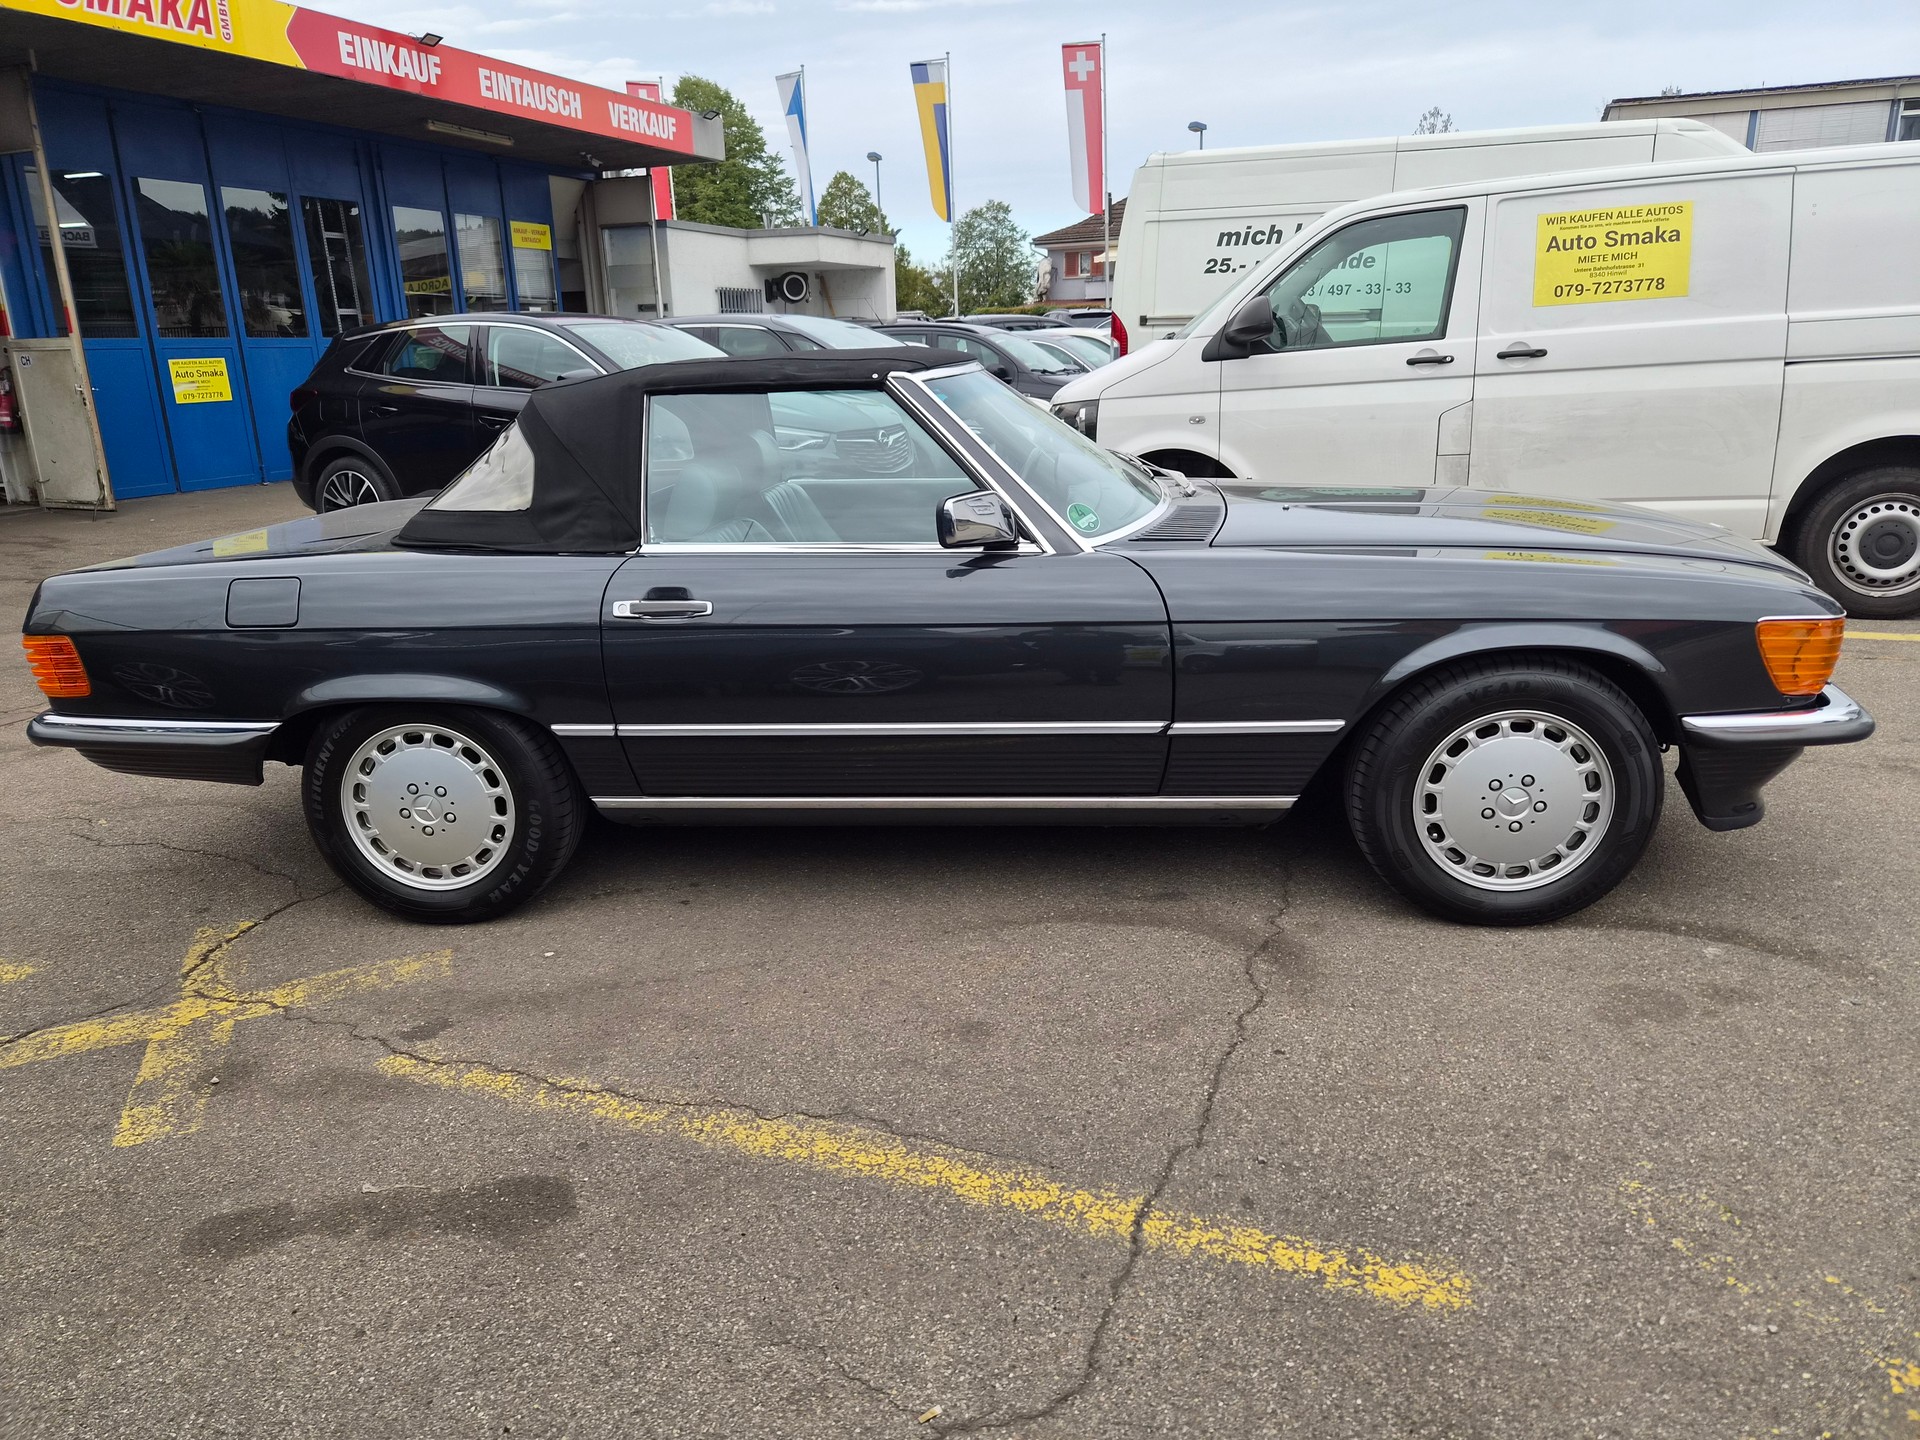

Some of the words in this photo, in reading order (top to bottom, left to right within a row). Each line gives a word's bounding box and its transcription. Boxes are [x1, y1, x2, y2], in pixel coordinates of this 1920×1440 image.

[56, 0, 213, 35] AKA
[337, 31, 441, 85] EINKAUF
[478, 67, 583, 120] EINTAUSCH
[608, 101, 676, 141] VERKAUF
[1546, 216, 1567, 226] WIR
[1569, 211, 1614, 224] KAUFEN
[1616, 208, 1643, 220] ALLE
[1645, 205, 1684, 217] AUTOS
[1216, 224, 1284, 247] mich
[1546, 234, 1598, 253] Auto
[1604, 225, 1681, 248] Smaka
[1203, 257, 1247, 274] 25.-
[1577, 253, 1609, 264] MIETE
[1611, 251, 1638, 261] MICH
[1593, 263, 1635, 272] Bahnhofstrasse
[1327, 284, 1352, 296] 497
[1365, 283, 1381, 295] 33
[1395, 282, 1412, 294] 33
[1554, 277, 1665, 298] 079-7273778
[20, 355, 31, 366] CH
[175, 370, 195, 378] Auto
[196, 368, 224, 377] Smaka
[182, 391, 224, 400] 079-7273778
[488, 799, 543, 904] GOODYEAR
